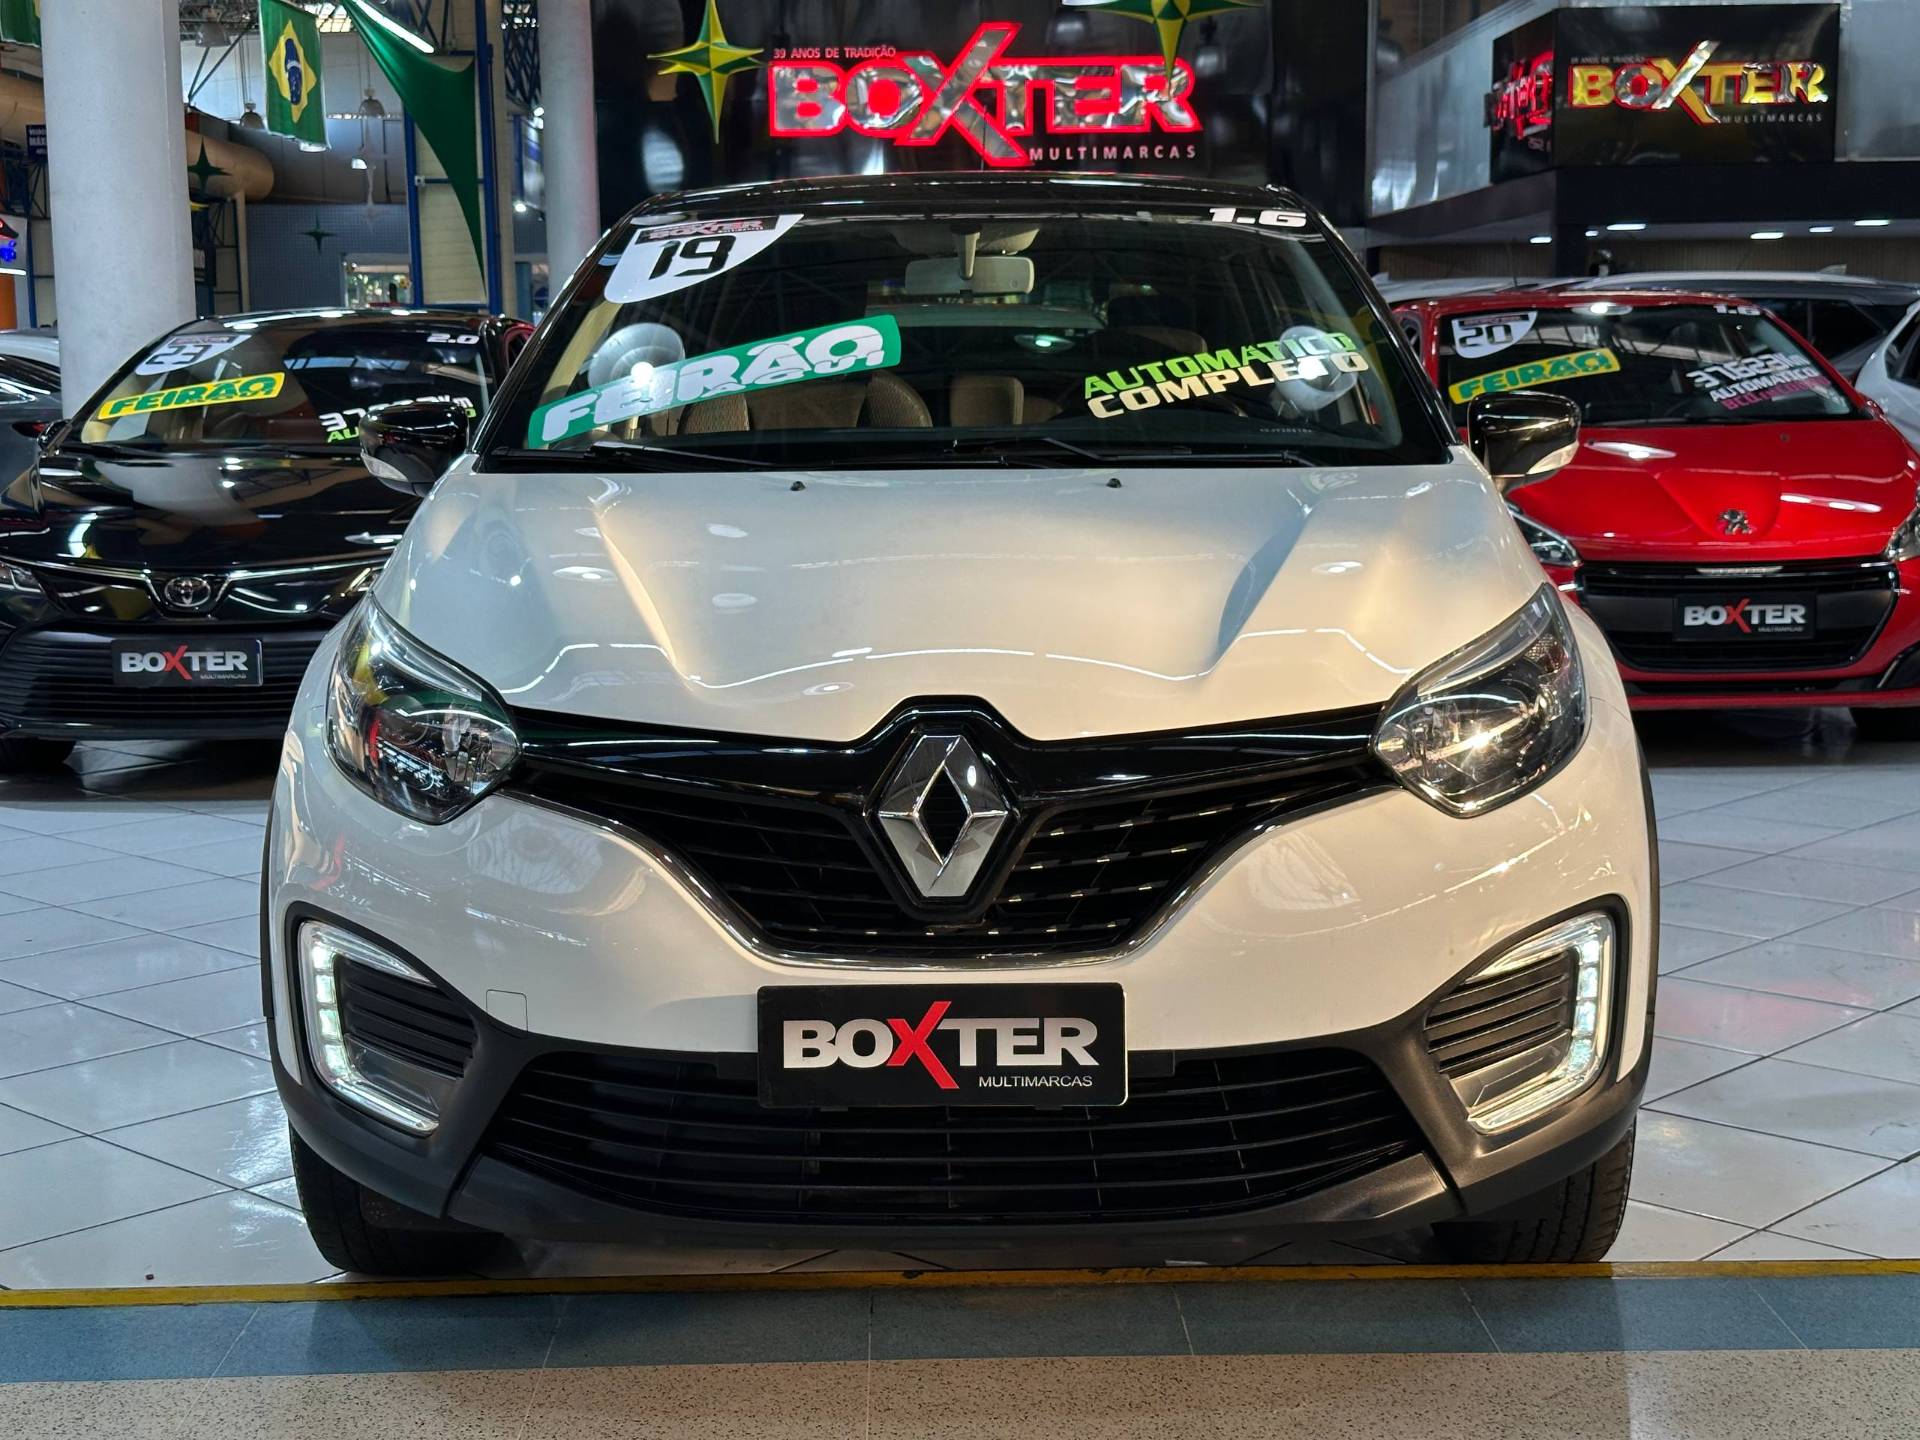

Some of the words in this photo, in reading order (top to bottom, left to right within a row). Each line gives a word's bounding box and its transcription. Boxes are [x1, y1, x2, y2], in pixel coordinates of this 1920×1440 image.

[790, 47, 820, 59] ANOS
[825, 47, 839, 59] DE
[844, 44, 896, 59] TRADIÇÃO
[769, 21, 1203, 167] BOXTER
[1567, 40, 1828, 127] BOXTER
[1721, 112, 1823, 124] MULTIMARCAS
[1029, 145, 1196, 160] MULTIMARCAS
[1208, 207, 1308, 228] 1.6
[648, 235, 737, 281] 19
[426, 332, 480, 345] 2.0
[1084, 332, 1357, 400] AUTOMATICO
[1709, 366, 1820, 402] AUTOMATICO
[1086, 352, 1370, 419] COMPLETO
[1683, 598, 1806, 633] BOXTER
[120, 645, 249, 681] BOXTER
[783, 1000, 1100, 1090] BOXTER
[979, 1075, 1093, 1088] MULTIMARCAS
